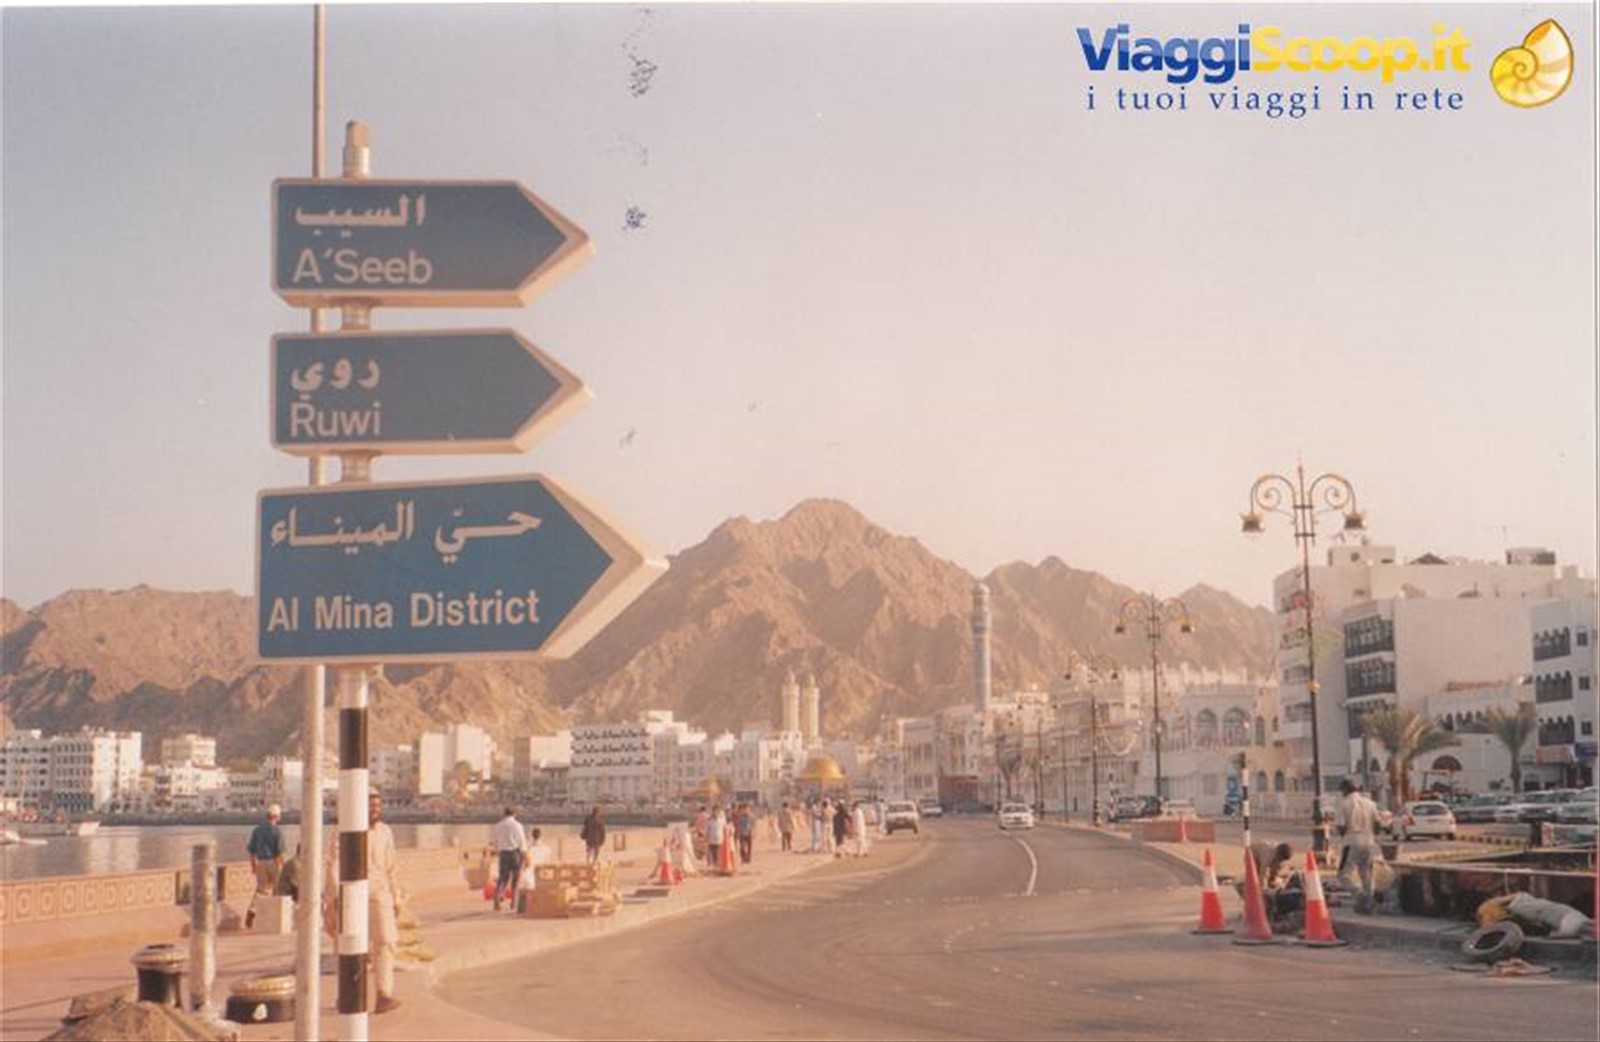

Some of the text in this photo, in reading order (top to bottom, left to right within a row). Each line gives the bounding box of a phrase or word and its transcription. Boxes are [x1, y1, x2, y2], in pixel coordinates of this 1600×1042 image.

[295, 194, 425, 238] السيب
[292, 248, 433, 285] A'Seeb
[291, 358, 380, 399] روي
[289, 402, 381, 437] Ruwi
[268, 589, 540, 633] Al Mina District
